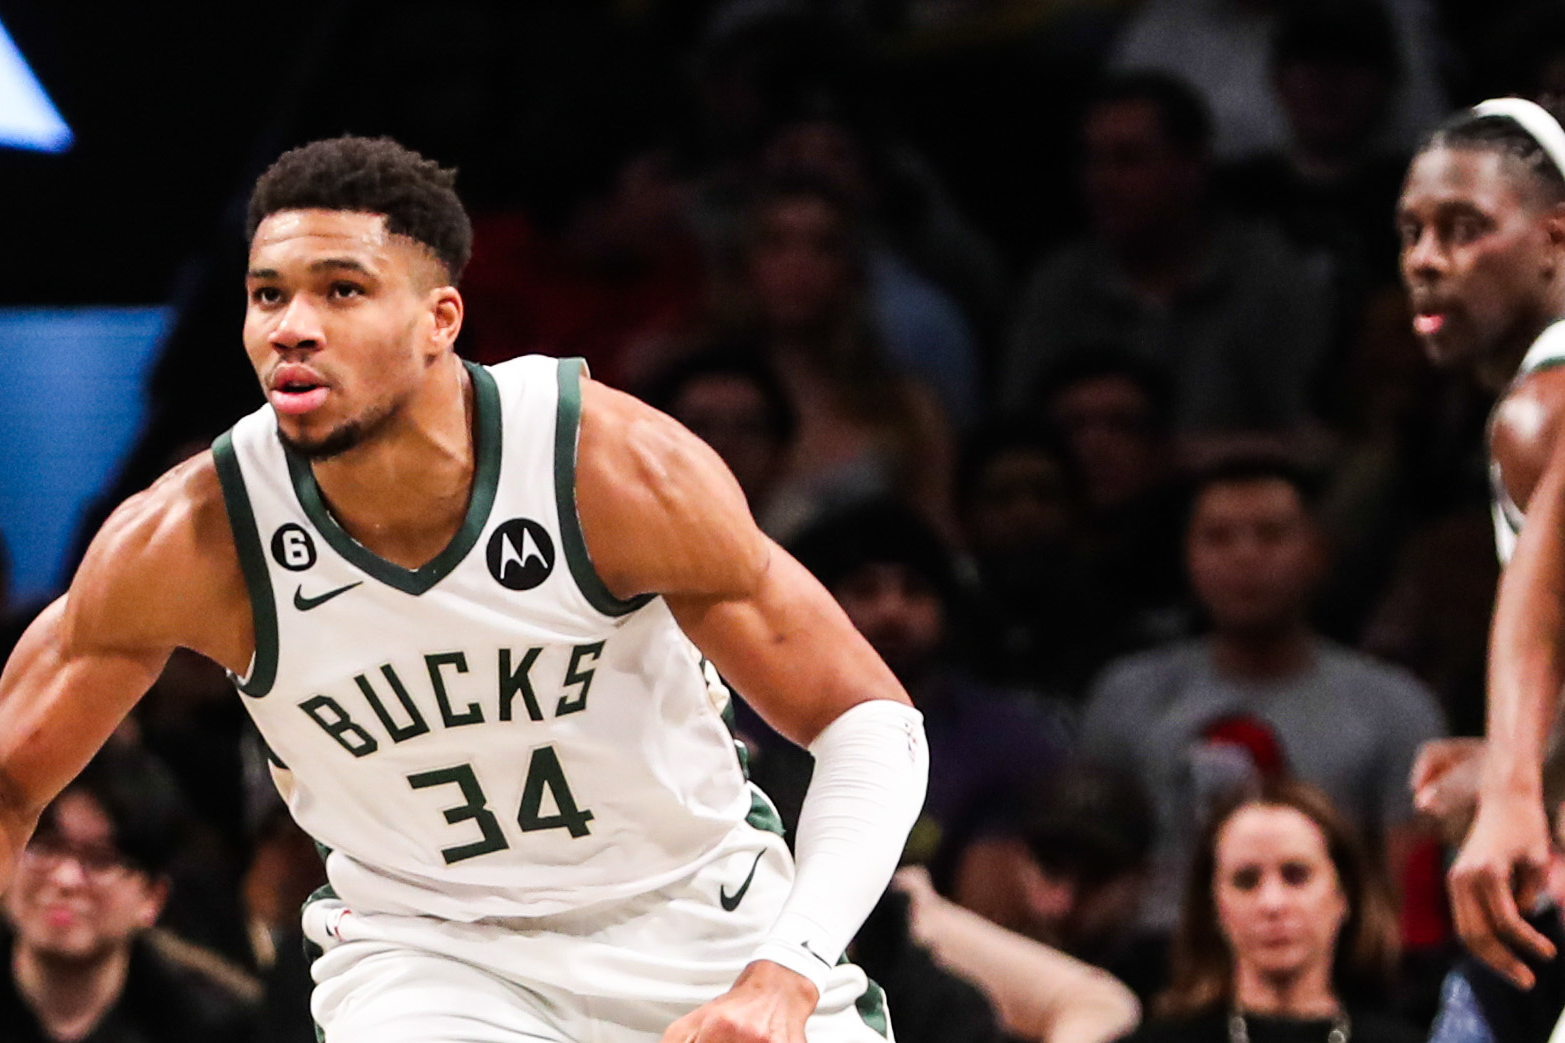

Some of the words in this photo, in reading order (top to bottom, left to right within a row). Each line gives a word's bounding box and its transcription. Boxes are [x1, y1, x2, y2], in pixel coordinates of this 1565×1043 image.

[281, 529, 312, 566] 6
[297, 639, 607, 759] BUCKS
[406, 745, 596, 866] 34
